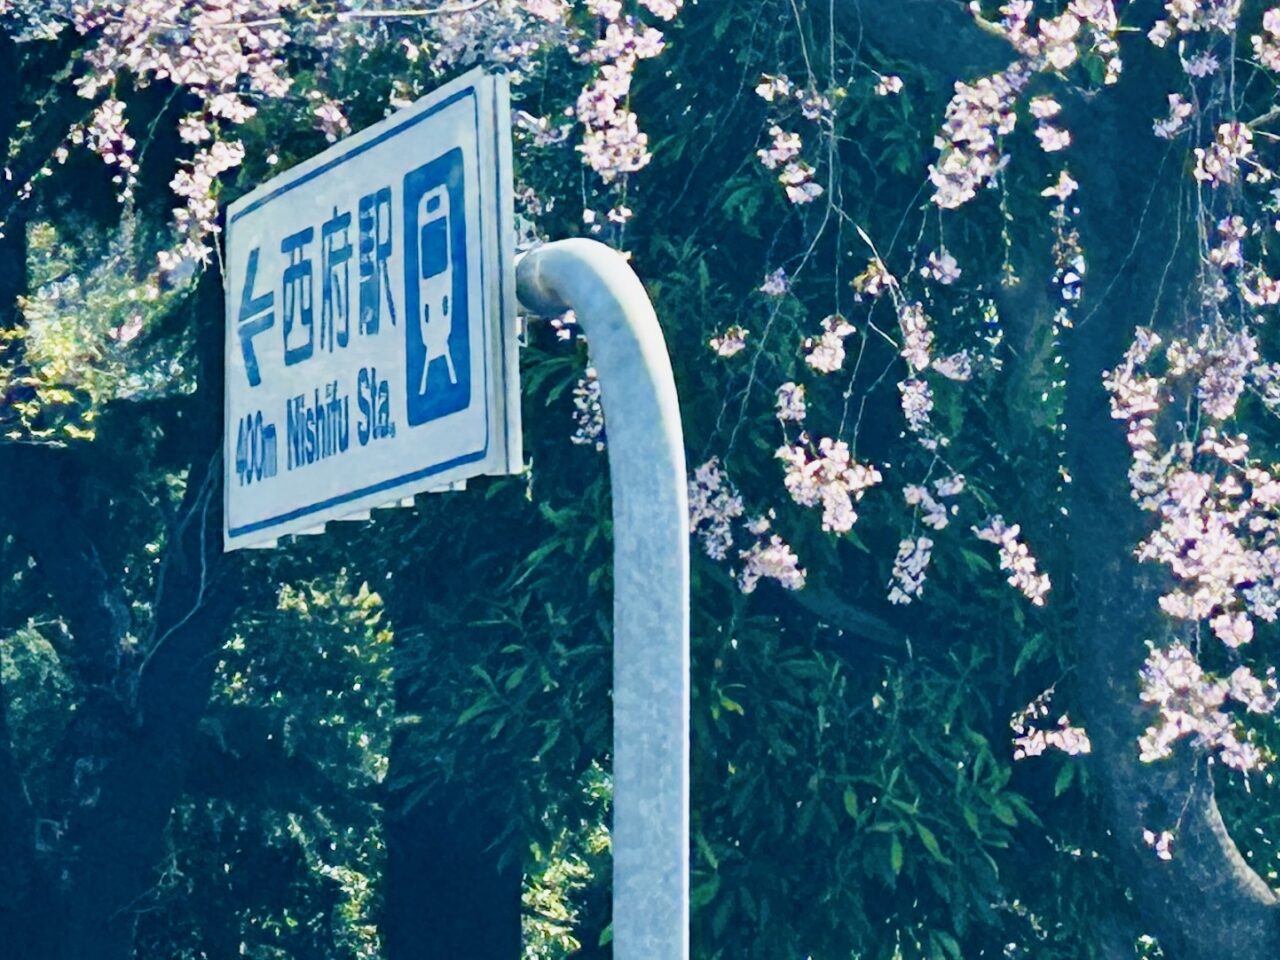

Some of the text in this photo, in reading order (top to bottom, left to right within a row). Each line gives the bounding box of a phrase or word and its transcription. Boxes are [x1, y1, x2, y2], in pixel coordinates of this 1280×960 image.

[281, 185, 396, 366] 西府駅
[236, 367, 396, 486] 400m Nishifu Sta.
